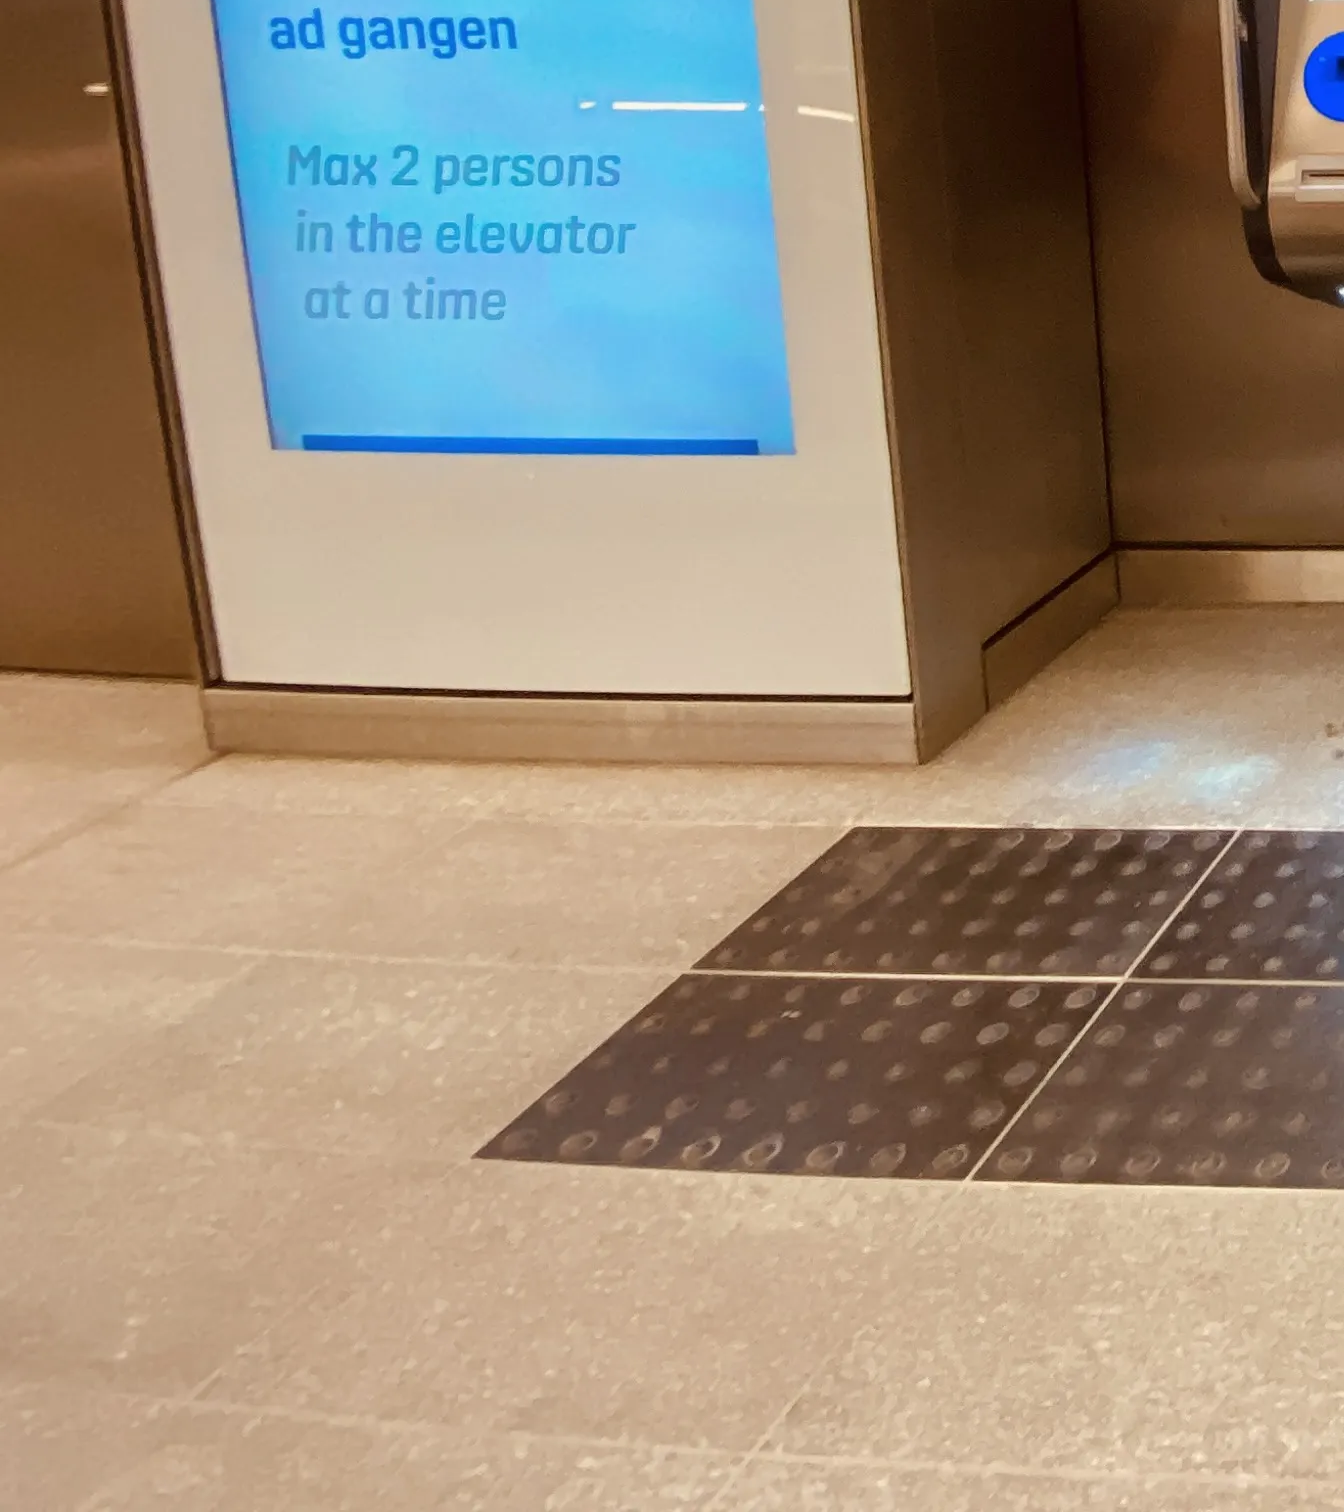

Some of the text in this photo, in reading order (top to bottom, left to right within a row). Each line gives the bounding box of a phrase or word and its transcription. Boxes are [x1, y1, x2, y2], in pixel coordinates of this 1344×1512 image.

[268, 7, 518, 60] ad gangen
[286, 144, 622, 195] Max 2 persons
[295, 208, 637, 255] in the elevator
[303, 277, 508, 322] at a time
